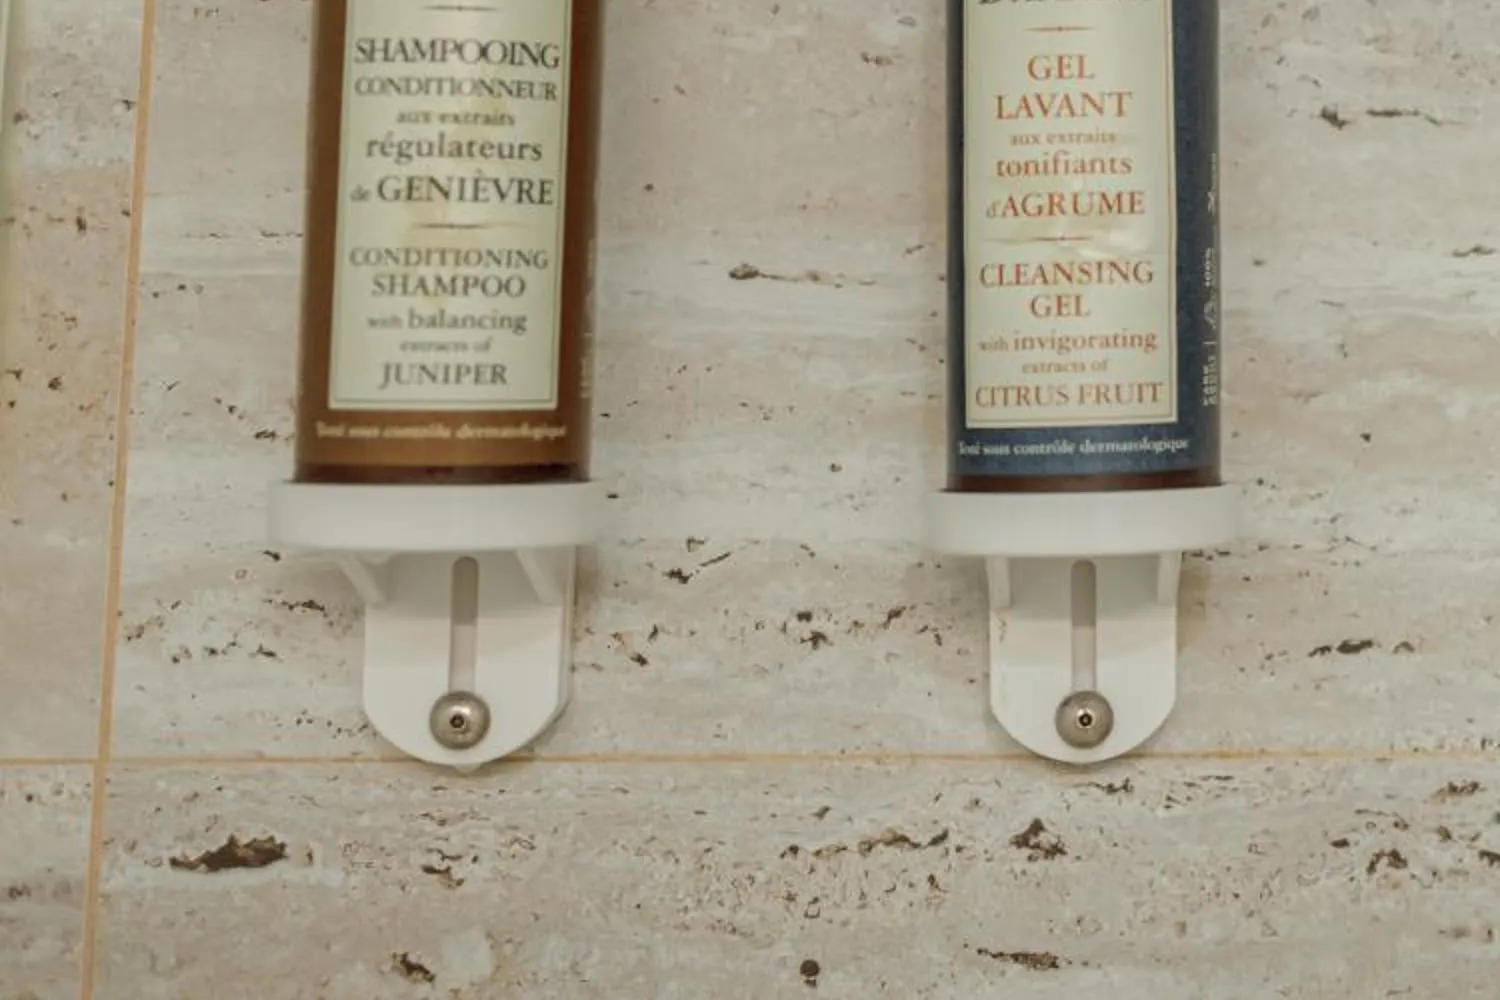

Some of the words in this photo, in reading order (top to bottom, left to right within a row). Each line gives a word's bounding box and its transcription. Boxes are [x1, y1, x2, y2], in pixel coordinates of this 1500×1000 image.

[354, 37, 560, 69] SHAMPOOING
[1027, 54, 1095, 81] GEL
[354, 76, 557, 101] CONDITIONNEUR
[438, 109, 515, 126] extraits
[995, 91, 1132, 121] LAVANT
[365, 131, 543, 165] régulateurs
[1010, 131, 1041, 145] aux
[1046, 127, 1118, 145] extraits
[996, 150, 1133, 178] tonifiants
[377, 168, 554, 206] GENIÈVRE
[349, 247, 550, 270] CONDITIONING
[371, 273, 527, 298] SHAMPOO
[979, 260, 1154, 288] CLEANSING
[1029, 294, 1091, 319] GEL
[408, 307, 527, 336] balancing
[1014, 328, 1158, 355] invigorating
[378, 362, 508, 391] JUNIPER
[975, 384, 1070, 409] CITRUS
[1077, 381, 1164, 405] FRUIT
